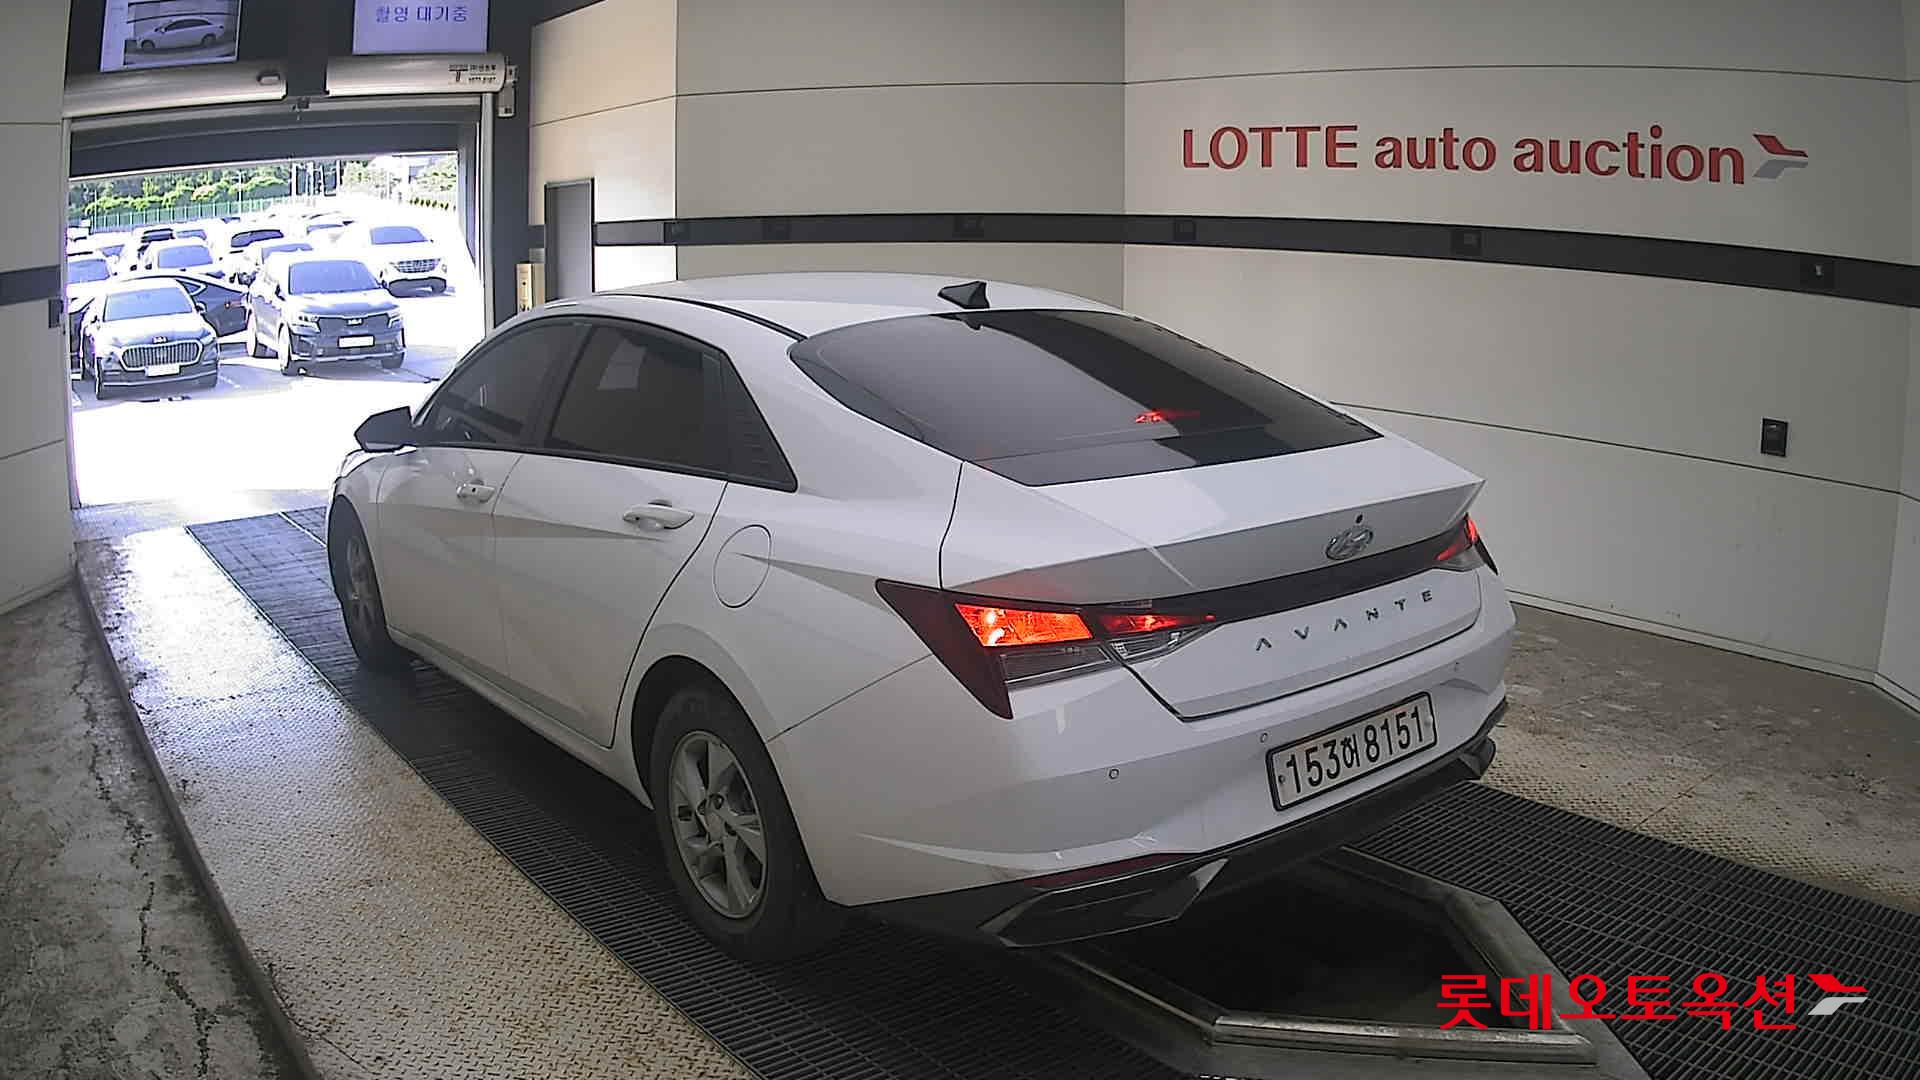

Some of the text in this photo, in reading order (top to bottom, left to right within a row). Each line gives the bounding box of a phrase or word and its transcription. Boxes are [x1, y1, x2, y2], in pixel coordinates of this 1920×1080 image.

[416, 5, 468, 23] 대기중
[1183, 125, 1745, 185] LOTTE auto auction
[1256, 589, 1433, 651] AVANTE
